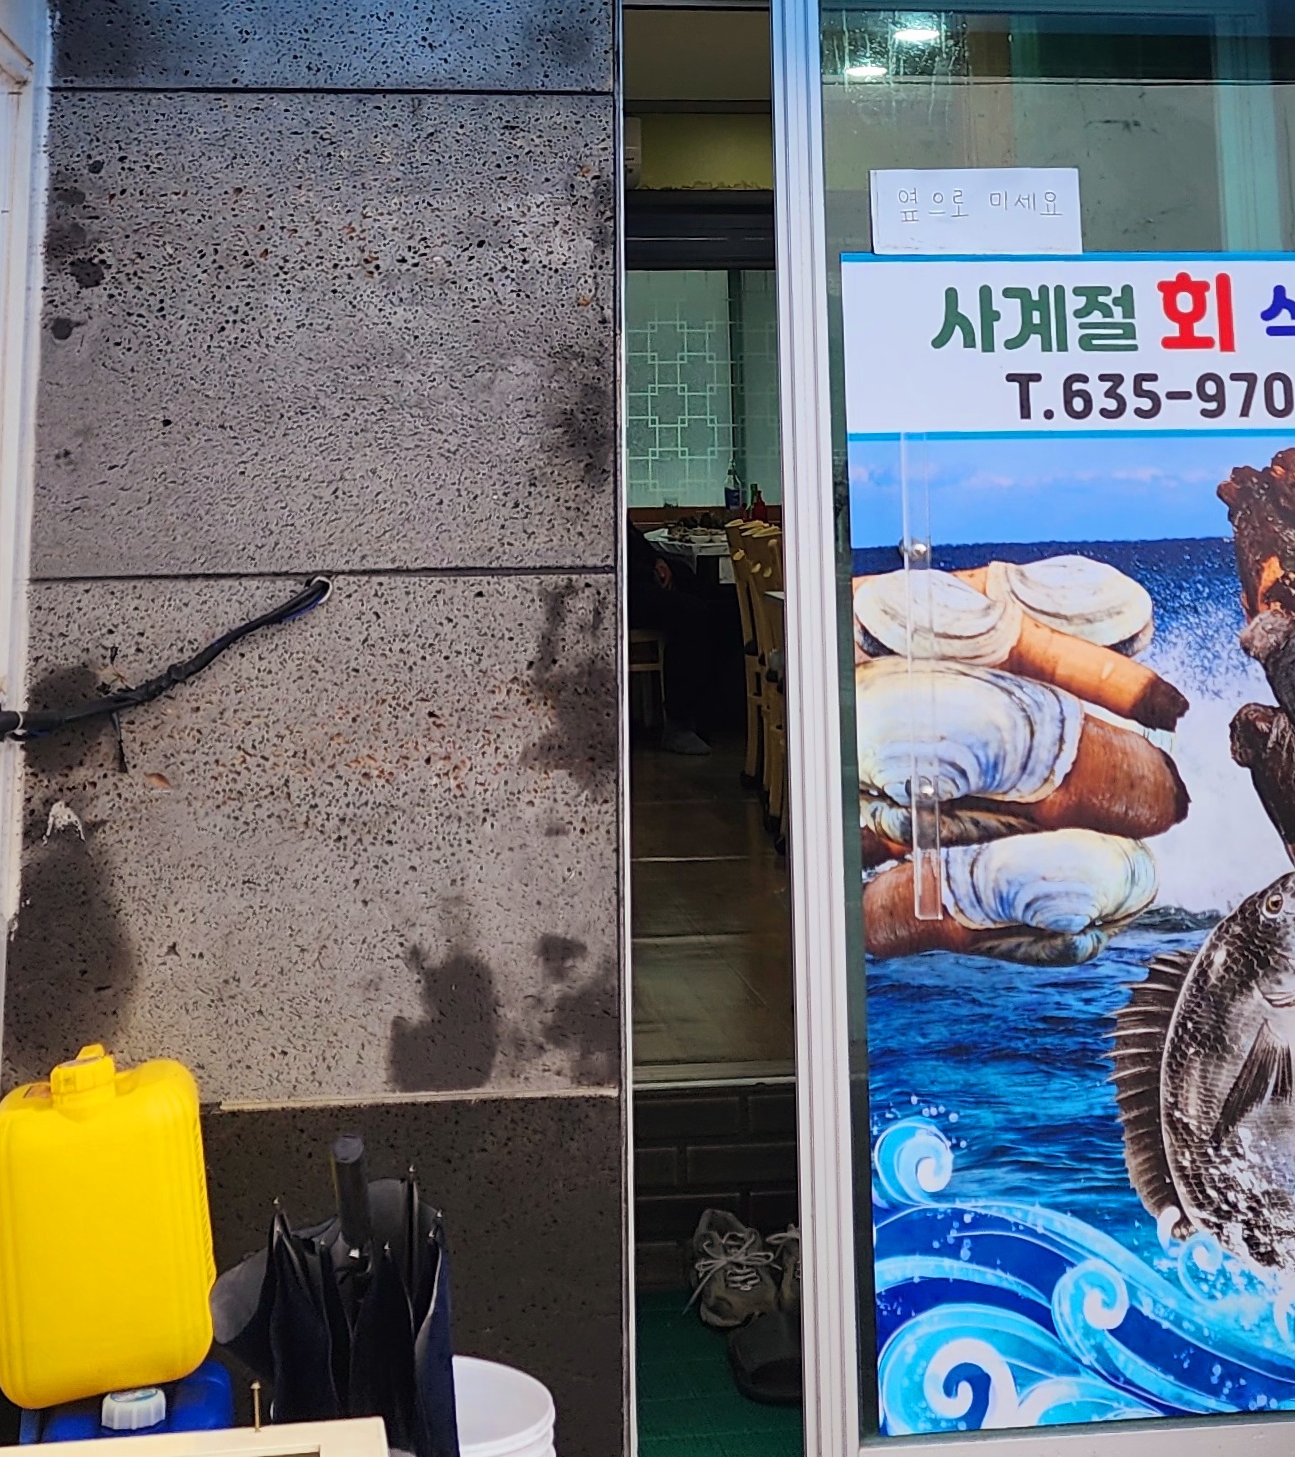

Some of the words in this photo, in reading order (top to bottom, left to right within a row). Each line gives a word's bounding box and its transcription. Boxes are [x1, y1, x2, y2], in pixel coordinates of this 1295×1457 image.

[898, 187, 969, 223] 옆으로
[990, 191, 1063, 216] 미세요
[931, 283, 1139, 353] 사계절
[1156, 271, 1236, 353] 회
